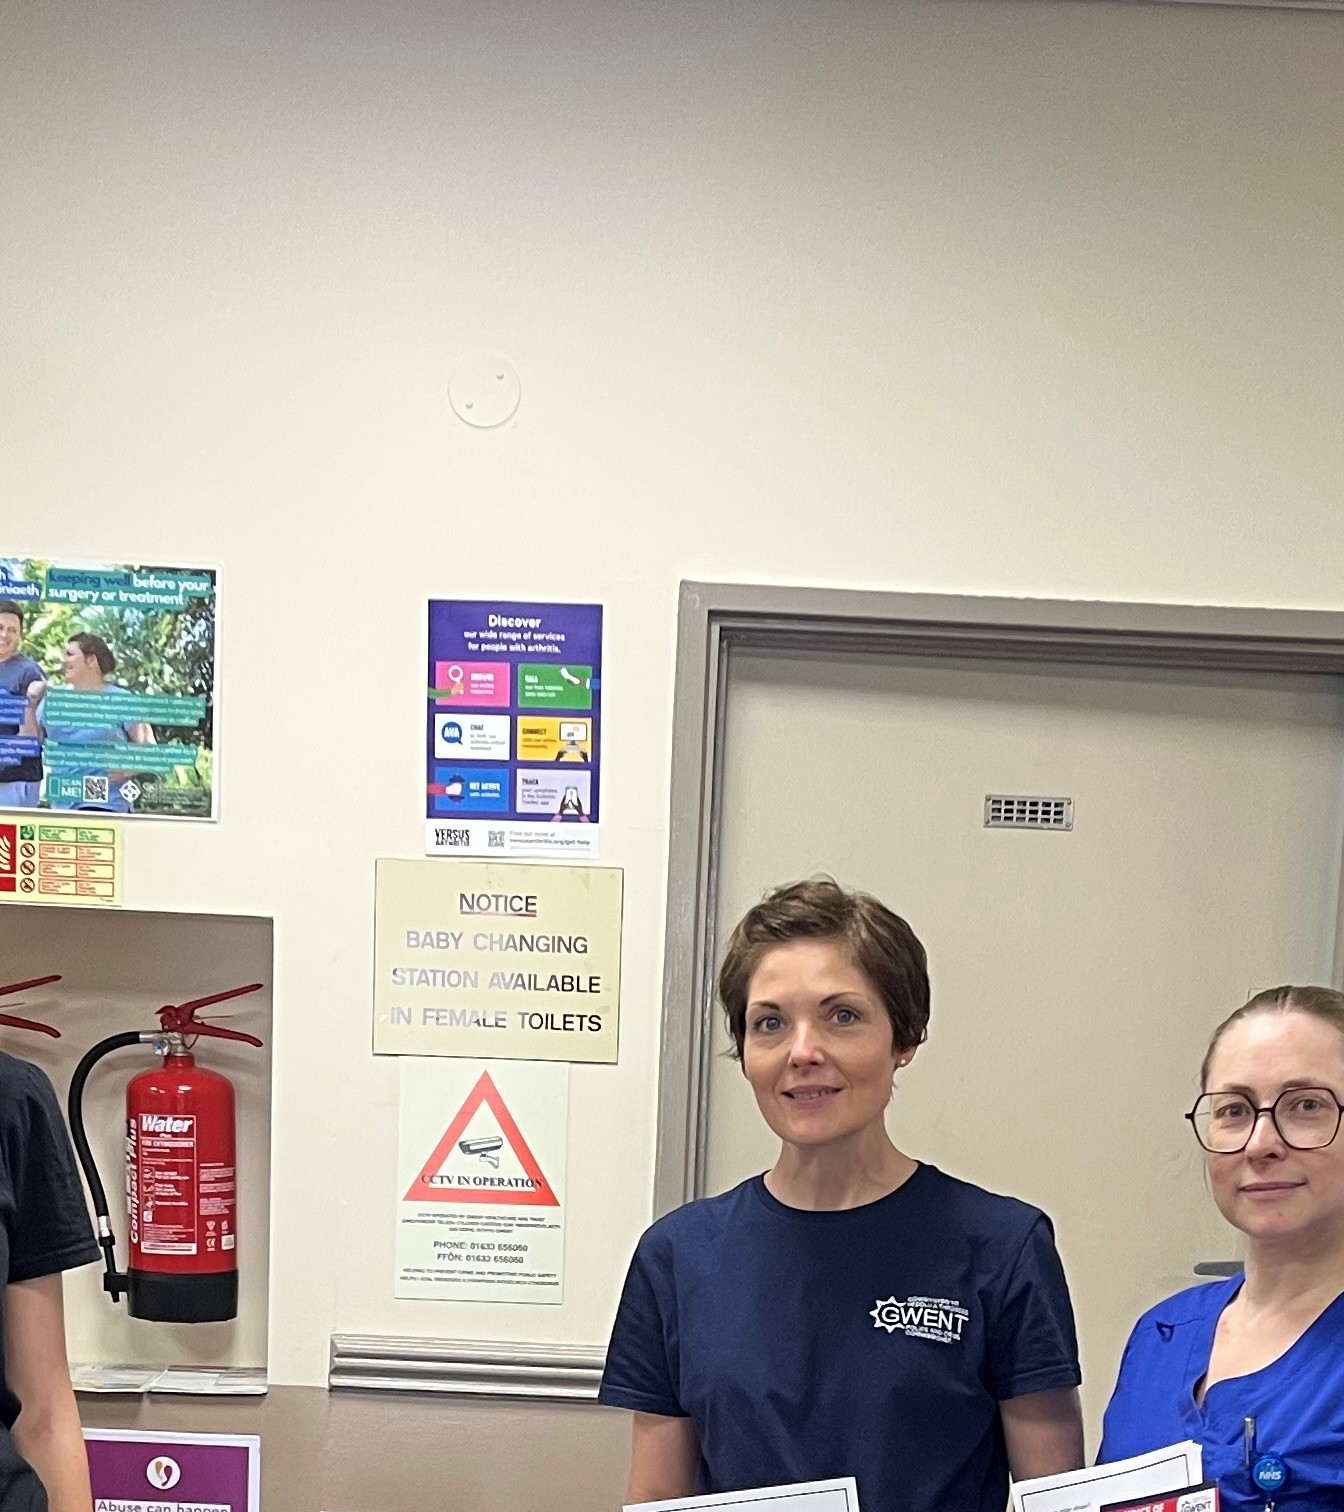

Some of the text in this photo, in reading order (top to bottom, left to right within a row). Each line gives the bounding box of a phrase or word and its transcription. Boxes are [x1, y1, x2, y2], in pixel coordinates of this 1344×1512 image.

[104, 575, 131, 587] well
[133, 573, 176, 590] before
[178, 580, 209, 592] your
[49, 588, 184, 605] surgery or treatment
[488, 614, 541, 628] Discover
[460, 893, 537, 913] NOTICE
[406, 931, 588, 954] BABY CHANGING
[391, 967, 601, 994] STATION AVAILABLE
[391, 1006, 602, 1032] IN FEMALE TOILETS
[142, 1115, 193, 1133] Water
[421, 1175, 542, 1188] CCTV IN OPERATION
[881, 1307, 969, 1334] GWENT
[1258, 1471, 1282, 1480] NHS
[98, 1501, 142, 1512] Abuse
